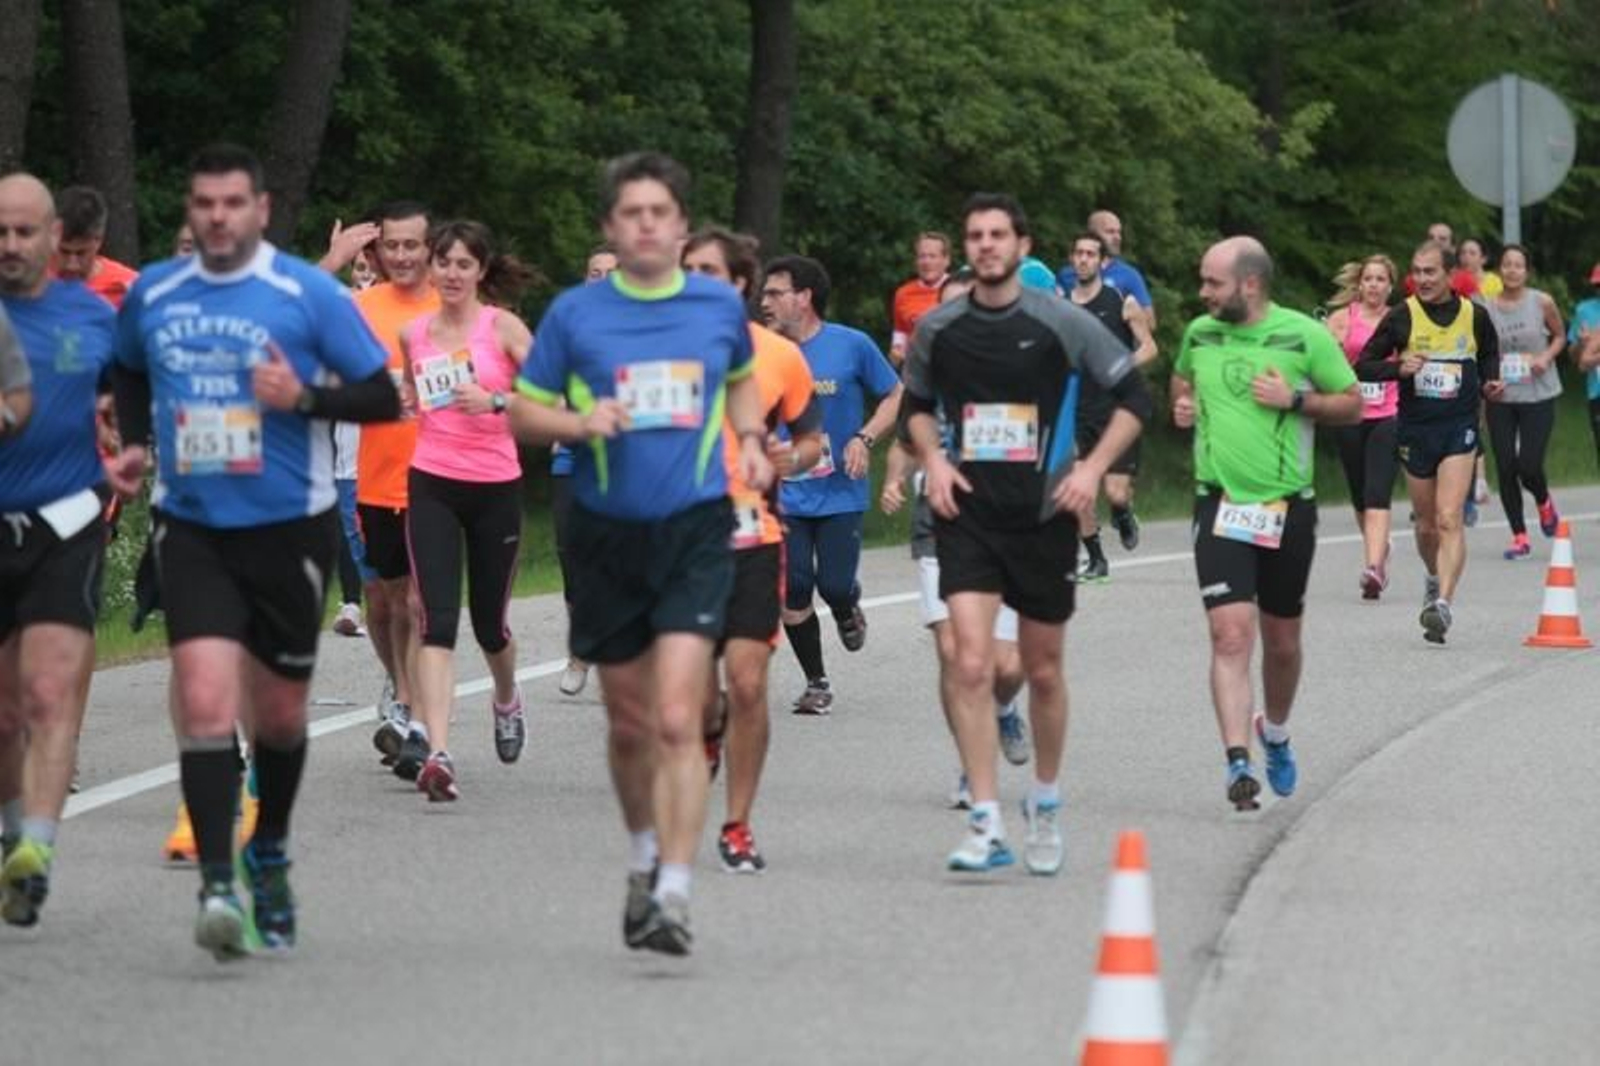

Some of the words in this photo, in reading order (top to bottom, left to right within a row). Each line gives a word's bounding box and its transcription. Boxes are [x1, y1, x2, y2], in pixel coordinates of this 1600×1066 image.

[424, 368, 461, 396] 191
[1422, 373, 1446, 388] 86
[183, 431, 235, 455] 651
[969, 424, 1018, 445] 228
[1222, 508, 1267, 531] 683
